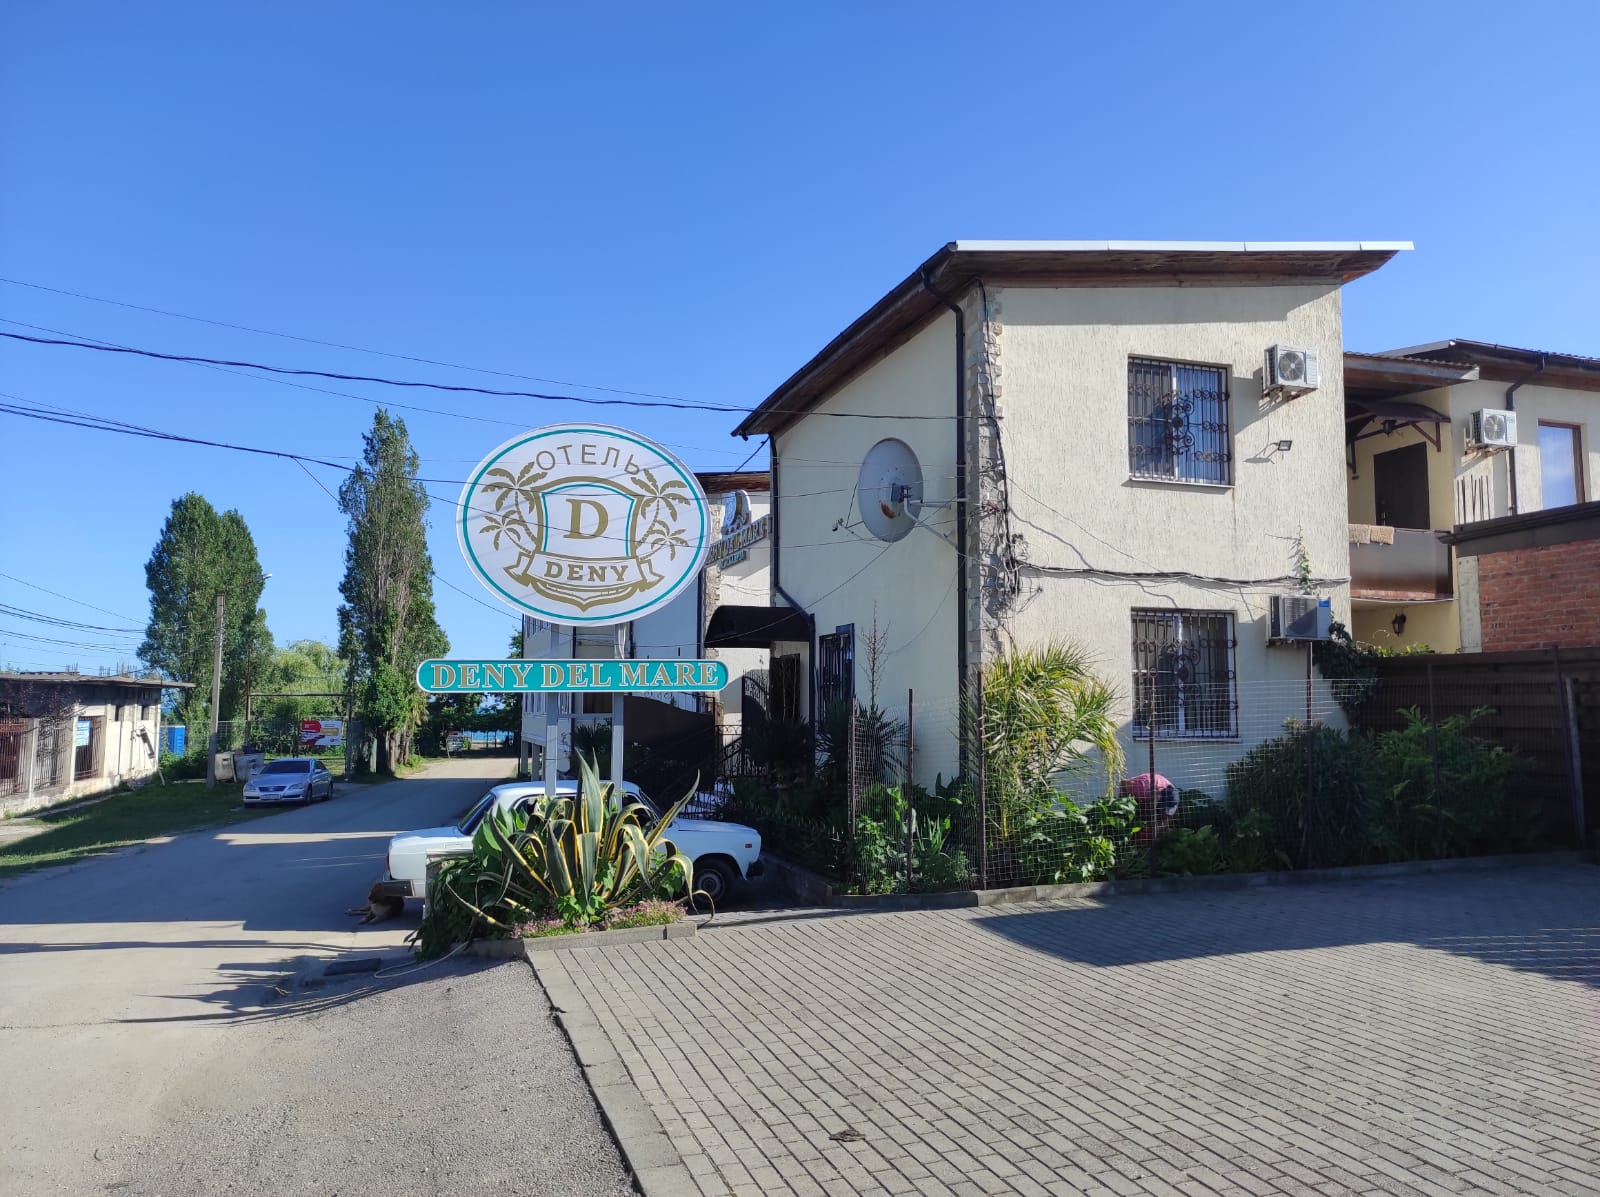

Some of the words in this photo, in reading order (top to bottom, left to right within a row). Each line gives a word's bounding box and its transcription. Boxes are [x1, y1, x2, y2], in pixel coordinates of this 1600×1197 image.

[535, 443, 641, 476] ОТЕЛЬ
[563, 498, 609, 540] D
[543, 560, 629, 582] DENY
[430, 662, 532, 689] DENY
[540, 662, 612, 688] DEL
[618, 661, 719, 688] MARE
